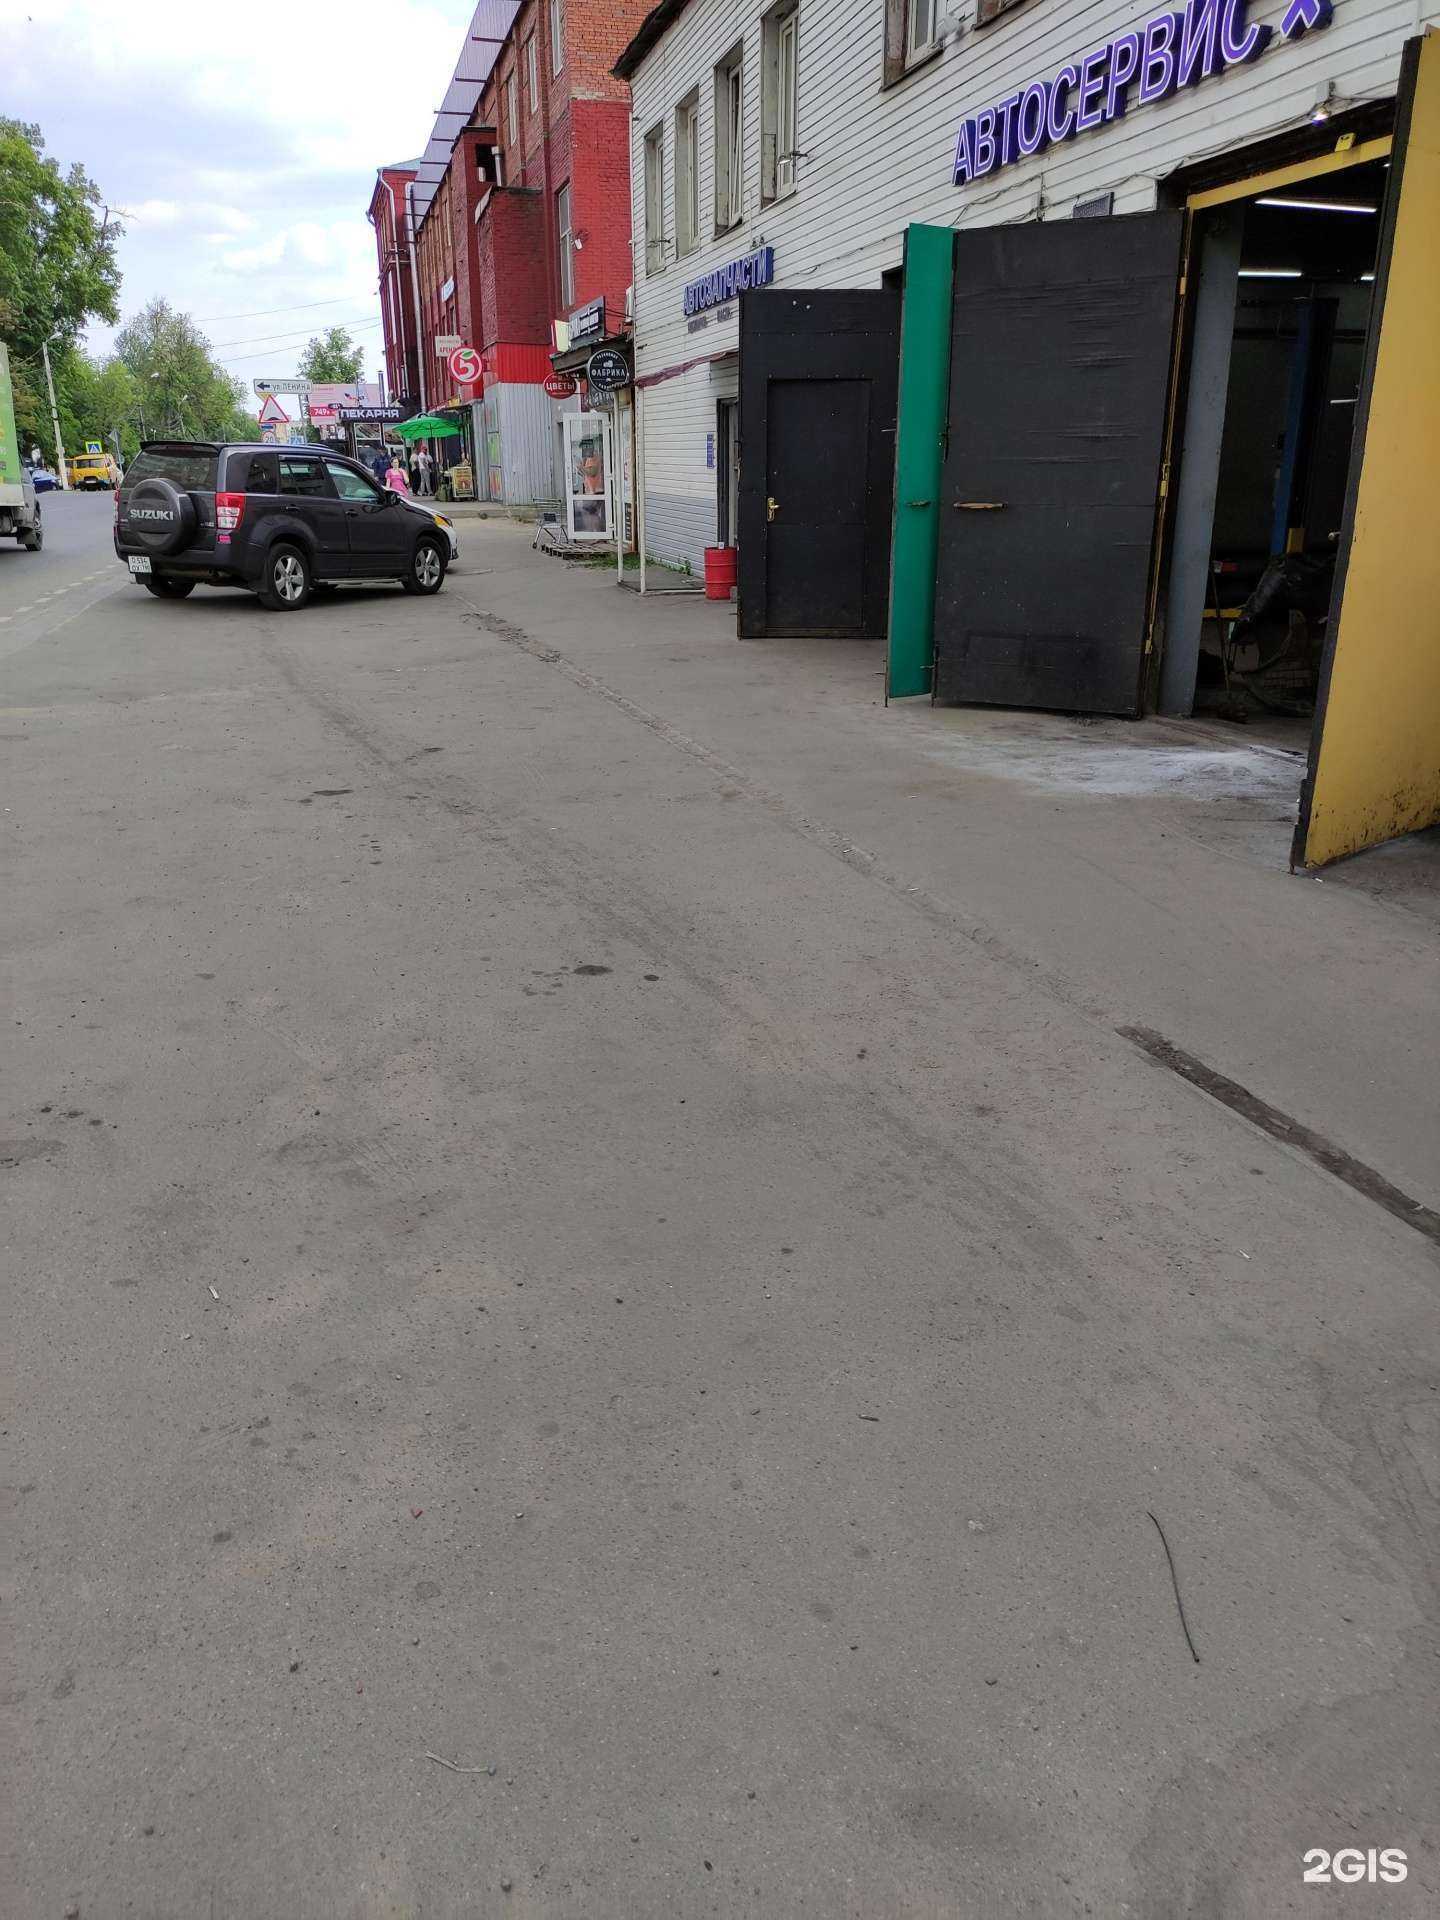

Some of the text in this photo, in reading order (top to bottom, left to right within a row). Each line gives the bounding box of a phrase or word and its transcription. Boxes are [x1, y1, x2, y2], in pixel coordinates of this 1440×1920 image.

[952, 0, 1266, 186] АВТОСЕРВИС
[684, 246, 773, 315] АВТОЗАПЧАСТИ
[591, 368, 625, 377] ФАБРИКА
[546, 382, 575, 392] ЦВЕТЫ
[340, 409, 400, 418] ПЕКАРНЯ
[130, 509, 174, 521] SUZUKI
